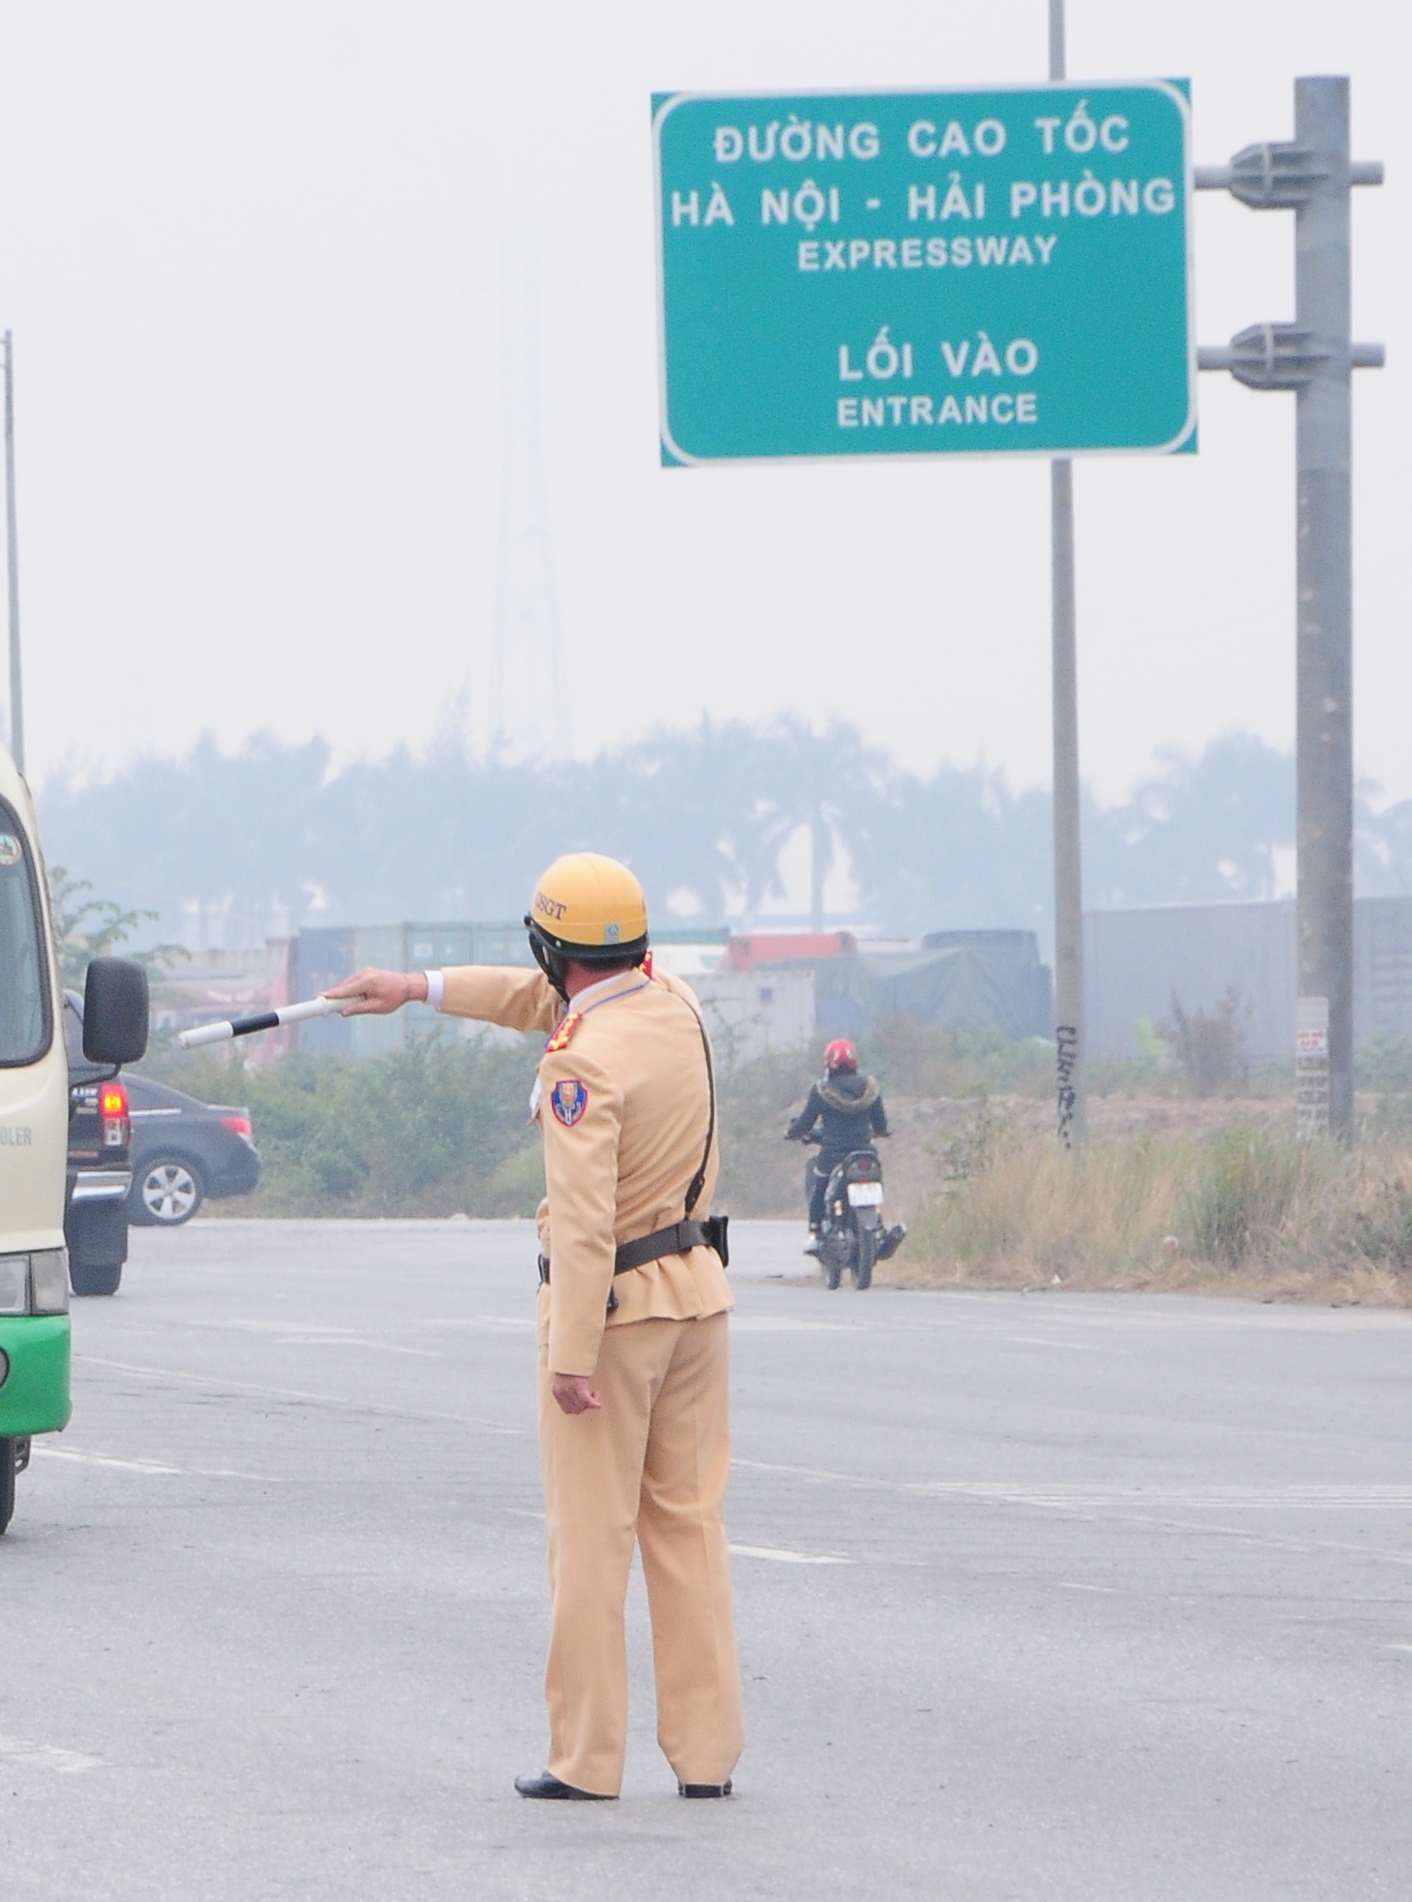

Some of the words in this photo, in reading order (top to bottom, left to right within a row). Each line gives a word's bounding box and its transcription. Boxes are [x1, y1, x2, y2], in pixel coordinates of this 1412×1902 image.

[714, 113, 880, 163] ĐƯỜNG
[907, 119, 1007, 158] CAO
[1035, 99, 1129, 155] TỐC
[671, 182, 735, 227] HÀ
[761, 178, 840, 231] NỘI
[908, 171, 986, 221] HẢI
[1010, 169, 1175, 218] PHÒNG
[798, 235, 1057, 271] EXPRESSWAY
[839, 325, 913, 381] LỐI
[941, 331, 1039, 377] VÀO
[837, 392, 1038, 428] ENTRANCE
